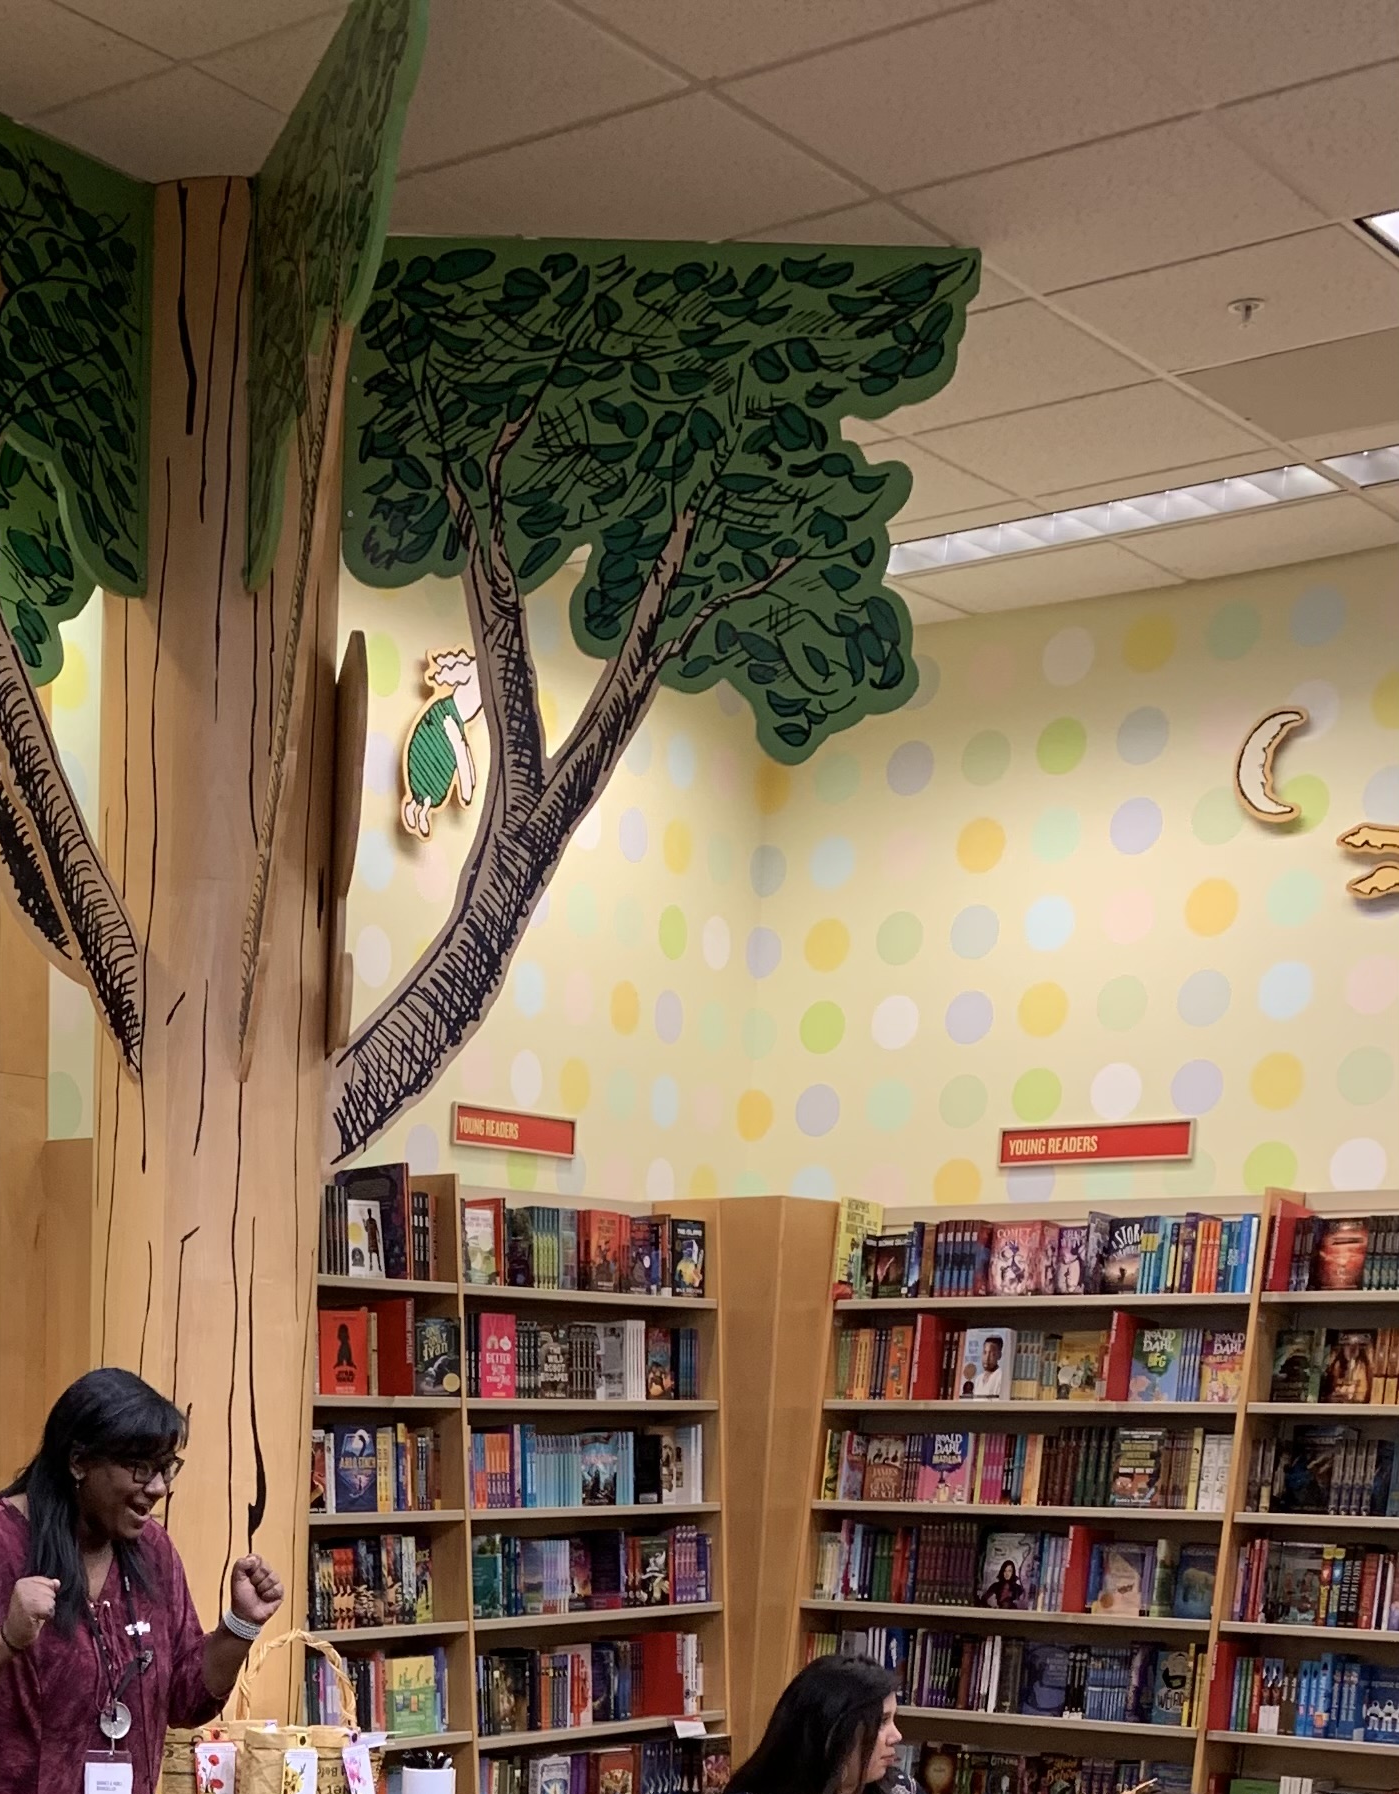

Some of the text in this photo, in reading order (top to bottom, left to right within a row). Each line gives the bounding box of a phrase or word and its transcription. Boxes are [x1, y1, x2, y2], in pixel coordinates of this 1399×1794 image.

[458, 1116, 520, 1140] YOUNG READERS
[1009, 1135, 1099, 1156] YOUNG READERS
[1144, 1330, 1176, 1341] ROALD
[1214, 1333, 1246, 1344] ROALD
[423, 1342, 449, 1362] Ivan
[1142, 1340, 1174, 1352] DAHL
[1213, 1343, 1243, 1355] DAHL
[486, 1353, 512, 1364] BETTER
[544, 1363, 566, 1372] ROBOT
[935, 1433, 963, 1443] ROALD
[935, 1443, 962, 1455] DAHL
